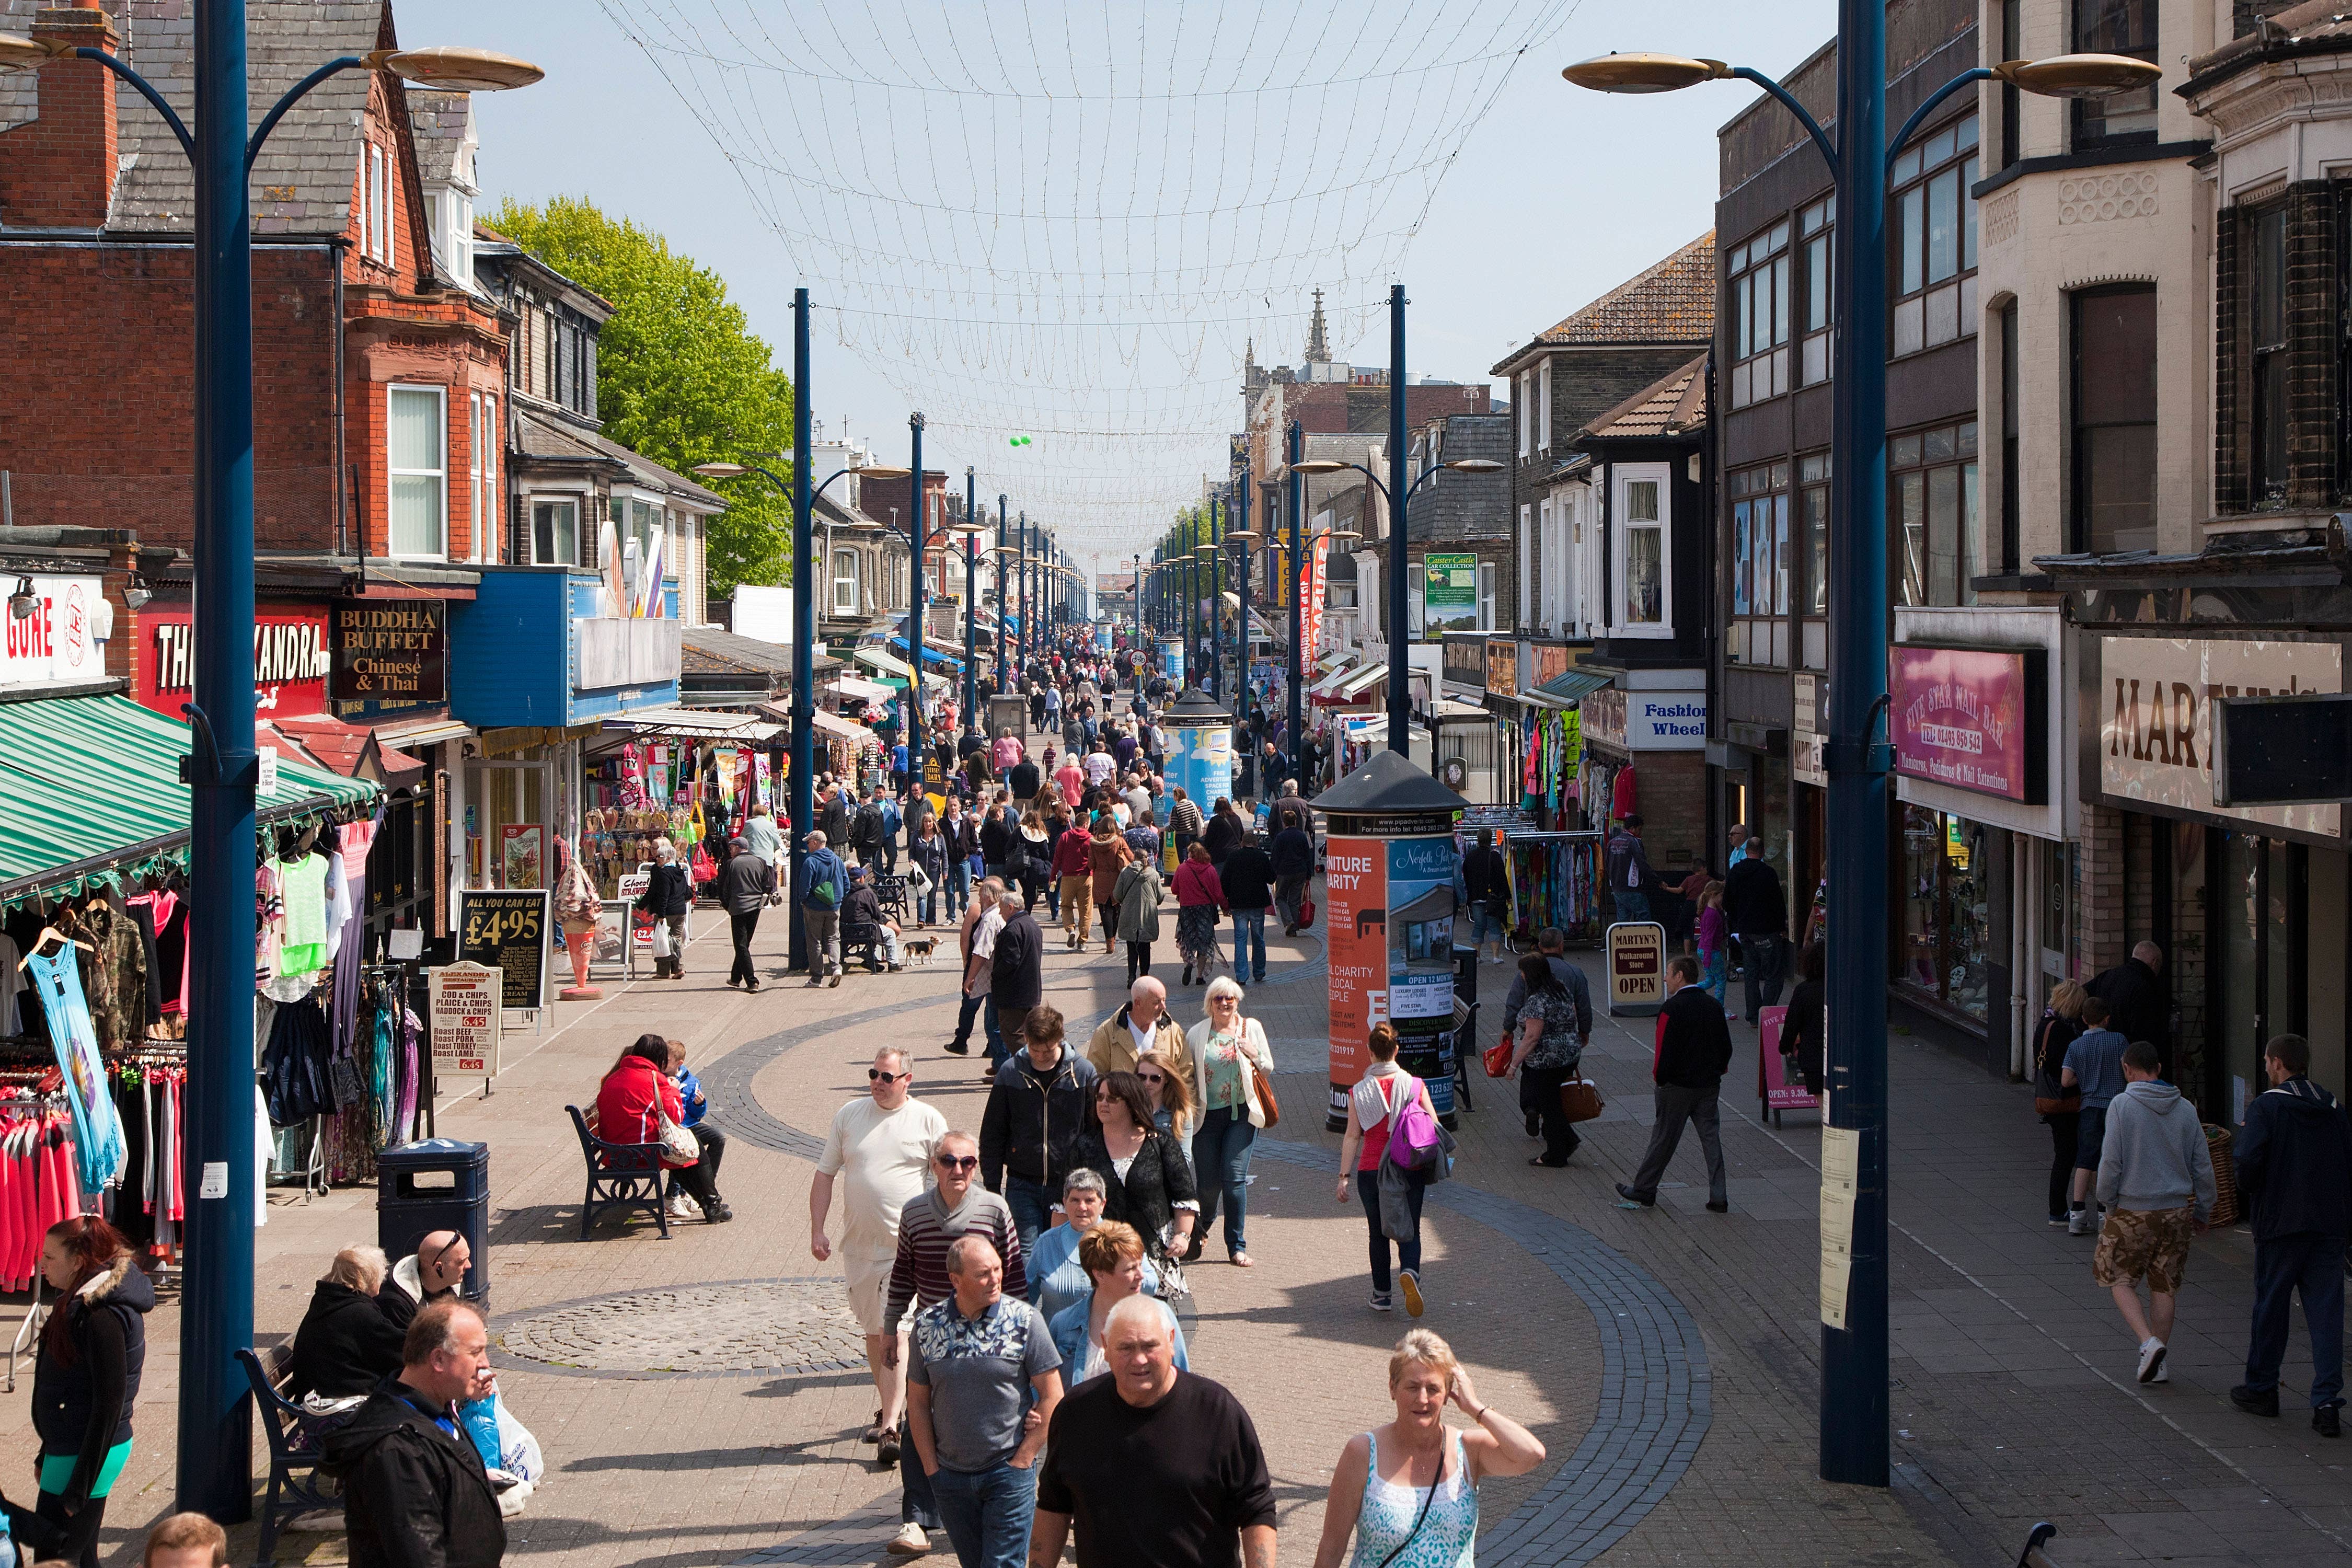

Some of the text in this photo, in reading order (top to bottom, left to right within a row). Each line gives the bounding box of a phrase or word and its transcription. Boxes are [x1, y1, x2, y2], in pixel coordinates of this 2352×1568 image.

[1427, 556, 1452, 564] Caister
[340, 610, 437, 628] BUDDHA
[7, 597, 52, 659] GONE
[343, 631, 433, 649] BUFFET
[833, 637, 845, 647] 19
[353, 658, 422, 674] Chinese
[356, 675, 419, 691] & Thai
[1906, 683, 2003, 751] FIVE STAR NAIL BAR
[1937, 727, 1955, 747] 01493
[1956, 730, 1967, 748] 856
[1969, 734, 1980, 751] 542
[1930, 757, 1955, 779] Pedicures
[1956, 764, 1961, 781] &
[1963, 765, 1975, 783] Nail
[622, 794, 634, 803] £5
[677, 793, 687, 802] £5
[1327, 855, 1371, 872] NITURE
[1396, 845, 1433, 870] Norfolk
[624, 878, 650, 887] Chocol
[1327, 873, 1360, 890] HARITY
[467, 898, 542, 908] ALL YOU CAN EAT
[1616, 935, 1656, 945] MARTYN'S
[1619, 952, 1654, 960] Walkaround
[1334, 965, 1374, 978] CHARITY
[1333, 978, 1356, 990] LOCAL
[1619, 977, 1655, 994] OPEN
[1329, 989, 1349, 1002] EOPLE
[463, 1017, 485, 1027] 6.45
[1763, 1016, 1779, 1027] FIVE
[1769, 1090, 1789, 1098] OPEN:
